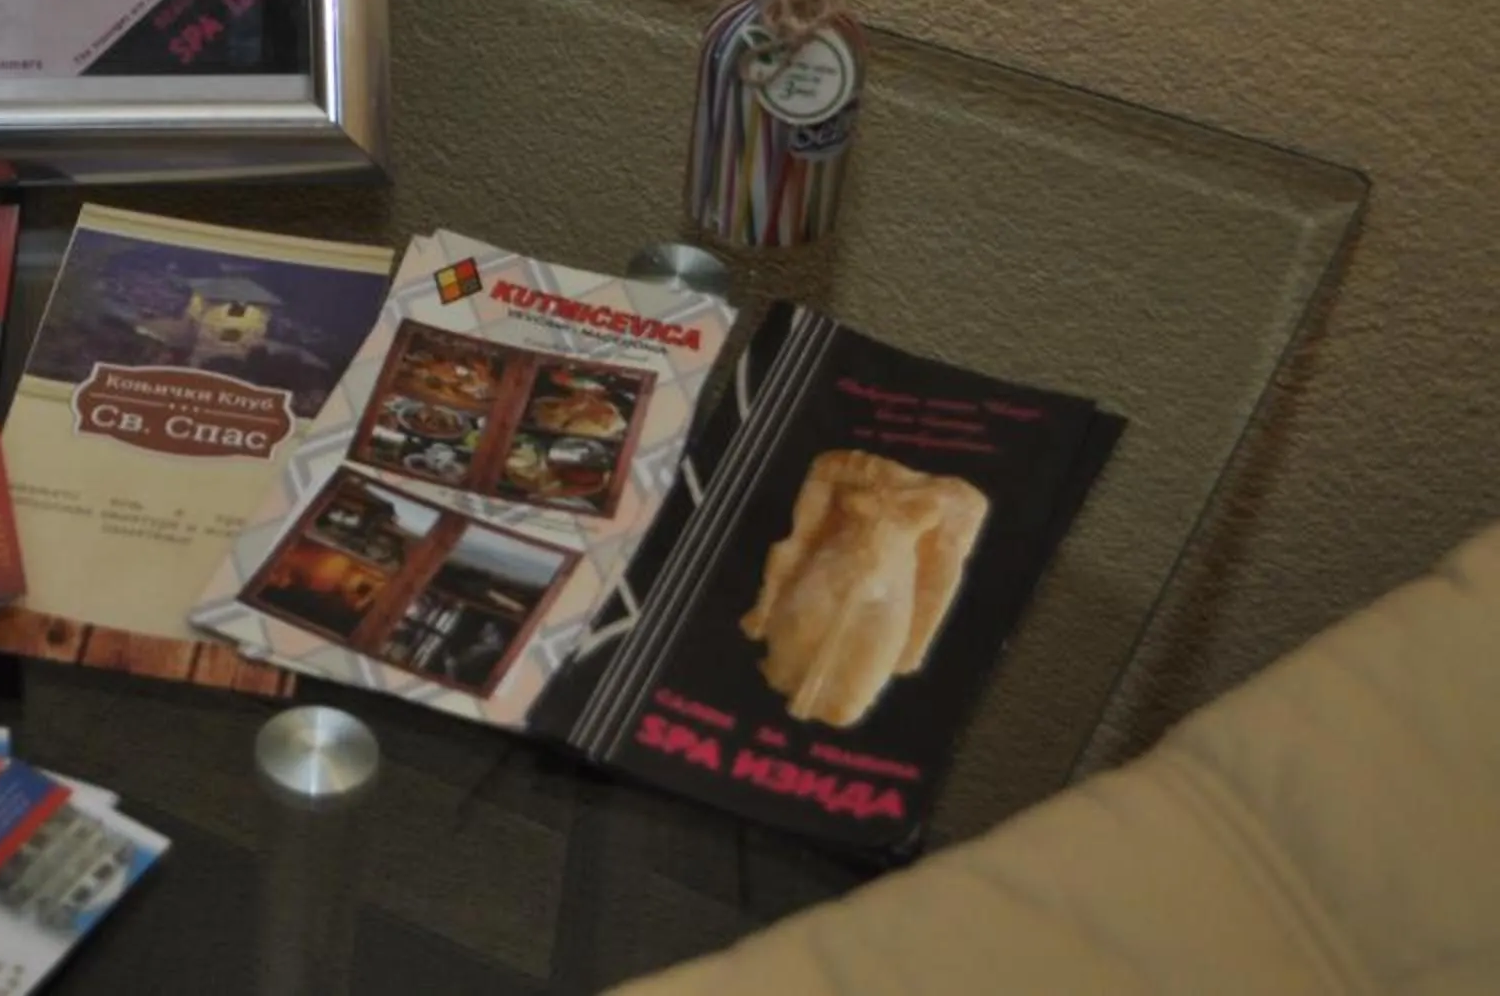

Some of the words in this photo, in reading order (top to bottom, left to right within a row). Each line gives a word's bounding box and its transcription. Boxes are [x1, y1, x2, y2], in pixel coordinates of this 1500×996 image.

[217, 390, 275, 414] Клуб
[90, 403, 152, 436] Св.
[164, 415, 269, 451] Спас
[634, 713, 722, 772] SPA
